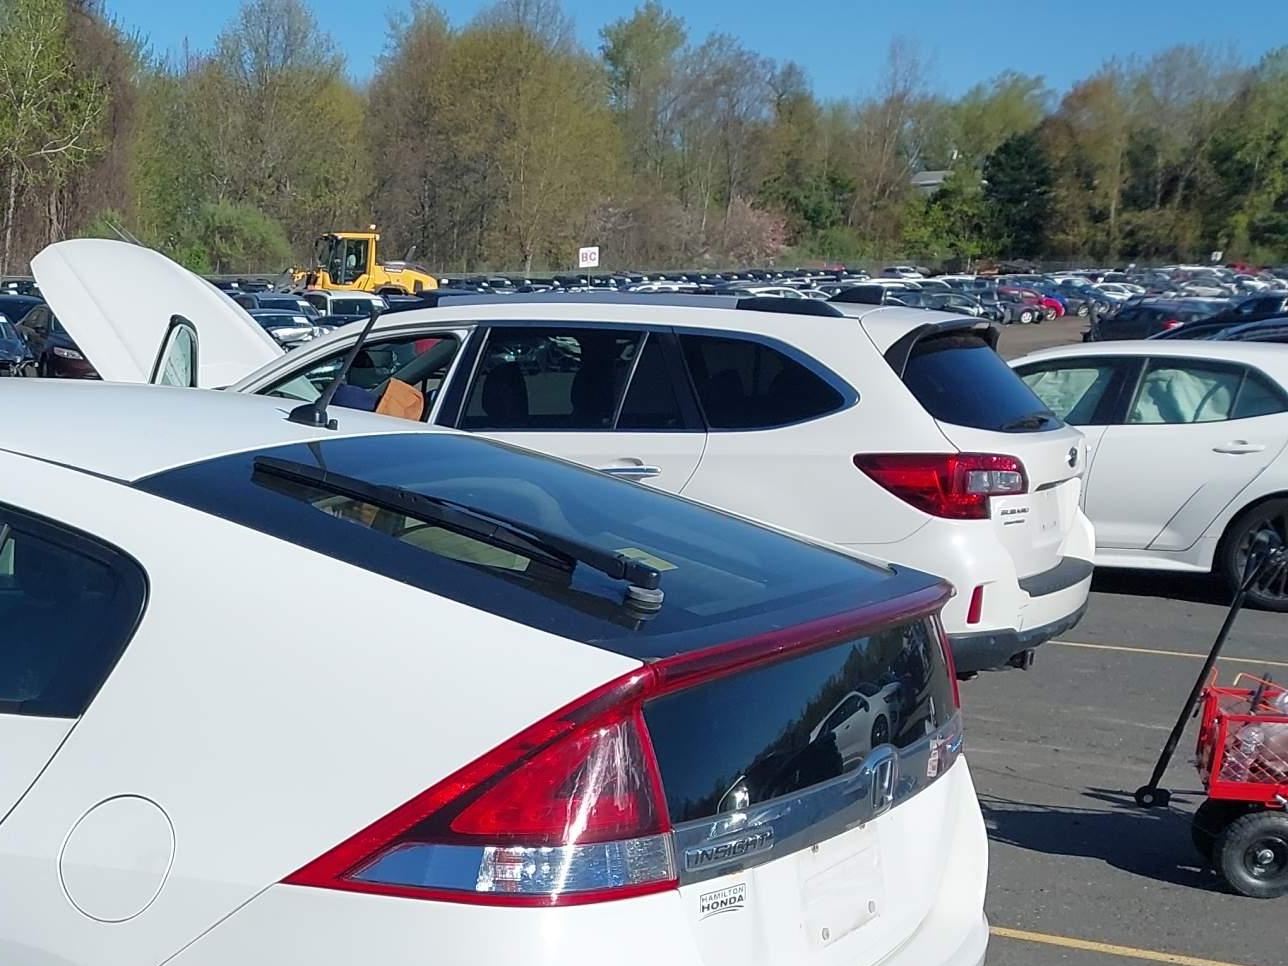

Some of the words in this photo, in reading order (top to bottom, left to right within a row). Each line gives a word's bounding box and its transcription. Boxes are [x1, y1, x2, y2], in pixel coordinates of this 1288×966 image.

[581, 251, 597, 262] BC
[695, 832, 770, 864] INSIGHT
[702, 886, 744, 903] HAMILTON
[702, 895, 744, 912] HONDA
